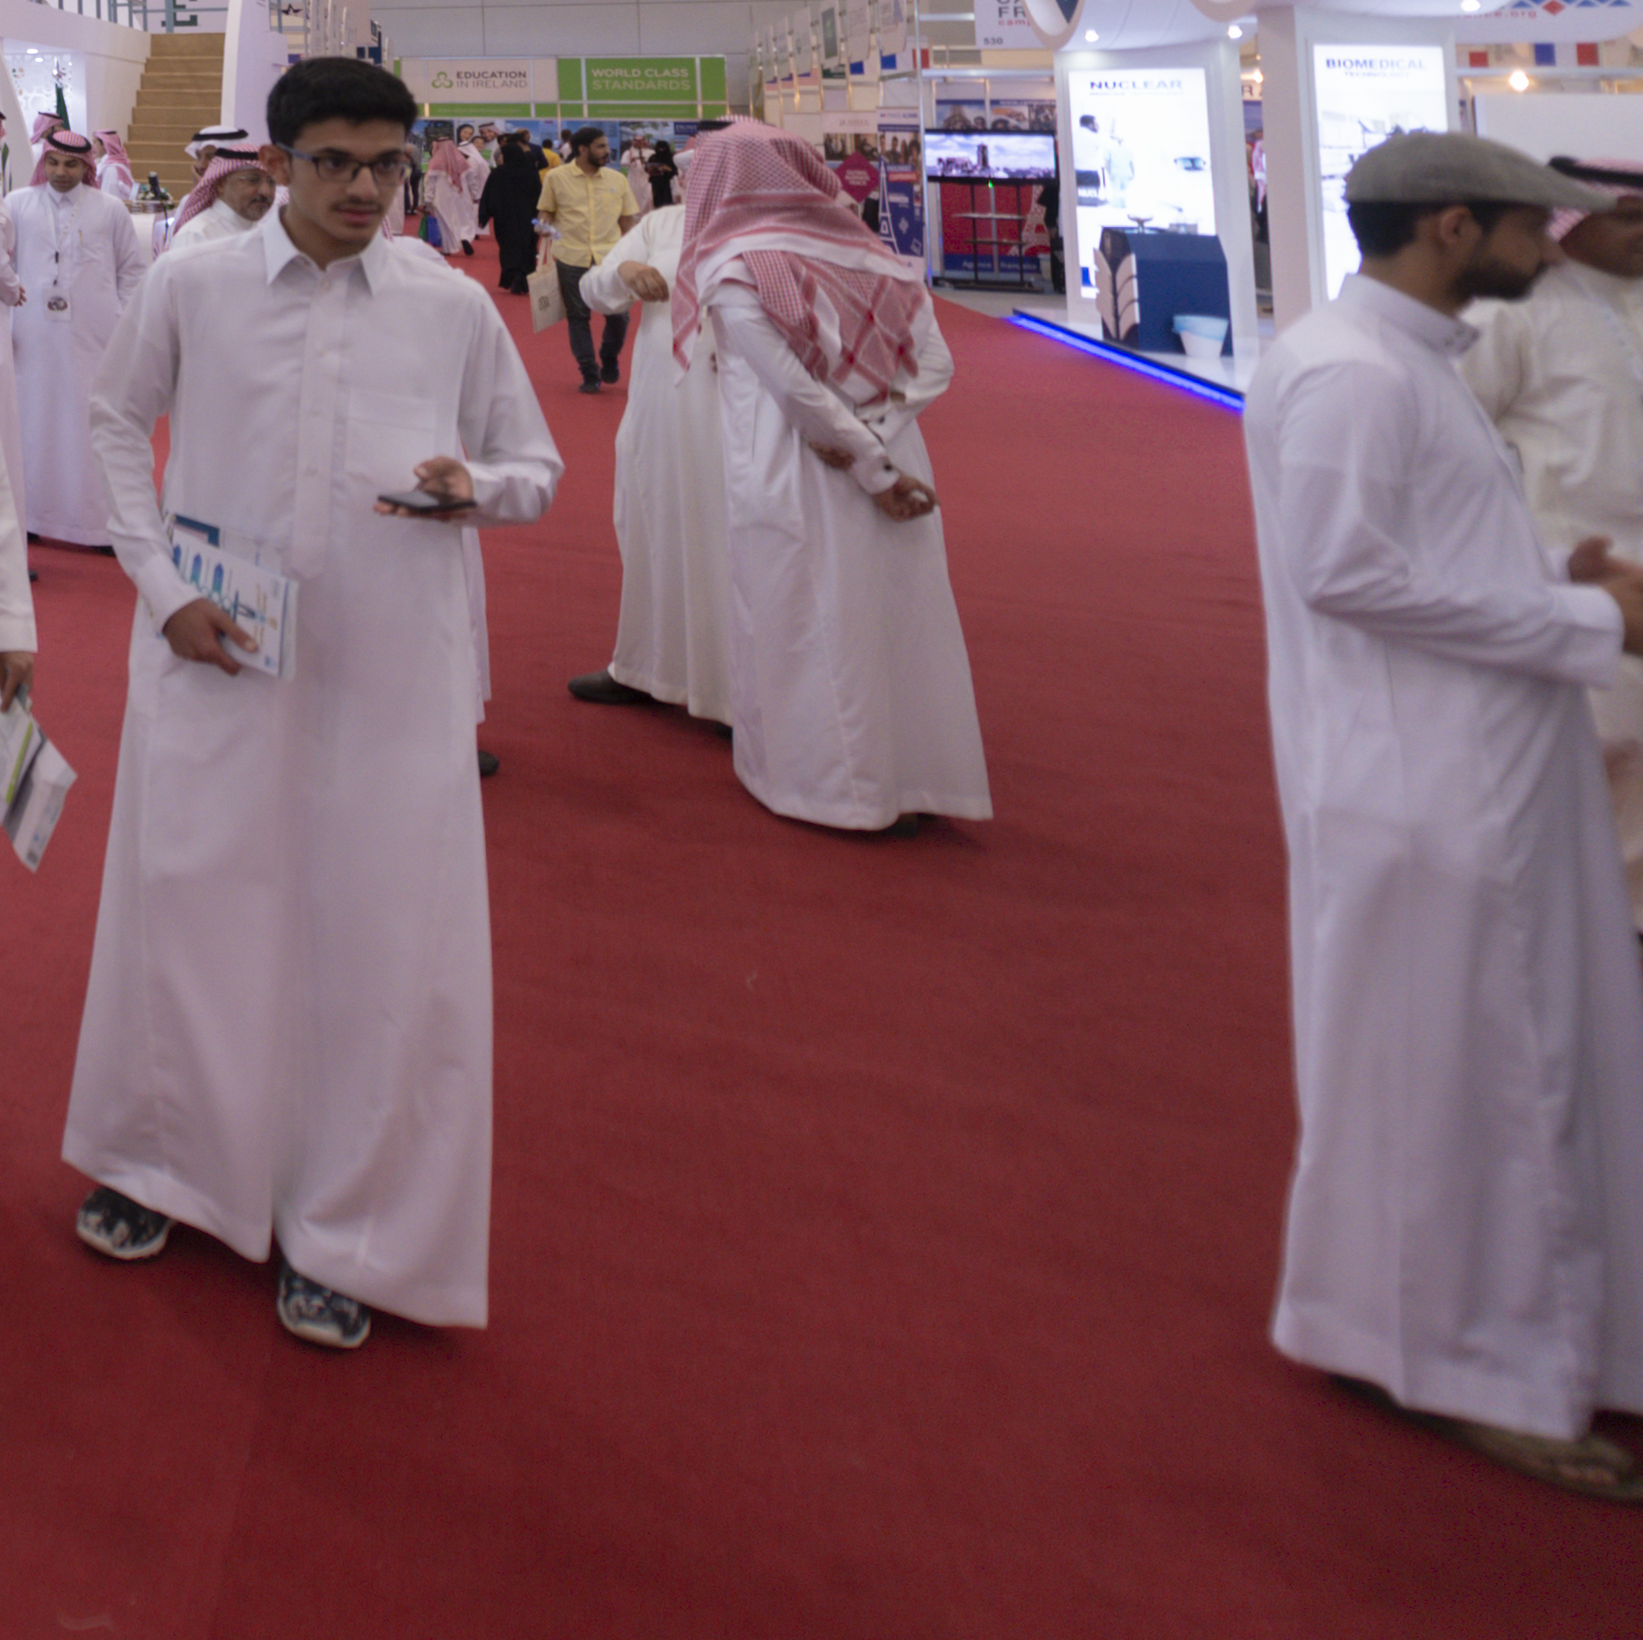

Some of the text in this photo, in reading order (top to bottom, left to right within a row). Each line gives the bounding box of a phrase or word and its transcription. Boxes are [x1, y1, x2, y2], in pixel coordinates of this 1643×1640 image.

[998, 6, 1026, 18] FR
[1326, 58, 1427, 70] BIOMEDICAL
[456, 70, 527, 80] EDUCATION
[591, 68, 689, 78] WORLD CLASS
[456, 79, 528, 89] IN IRELAND
[591, 79, 691, 90] STANDARDS
[1089, 80, 1183, 90] NUCLEAR
